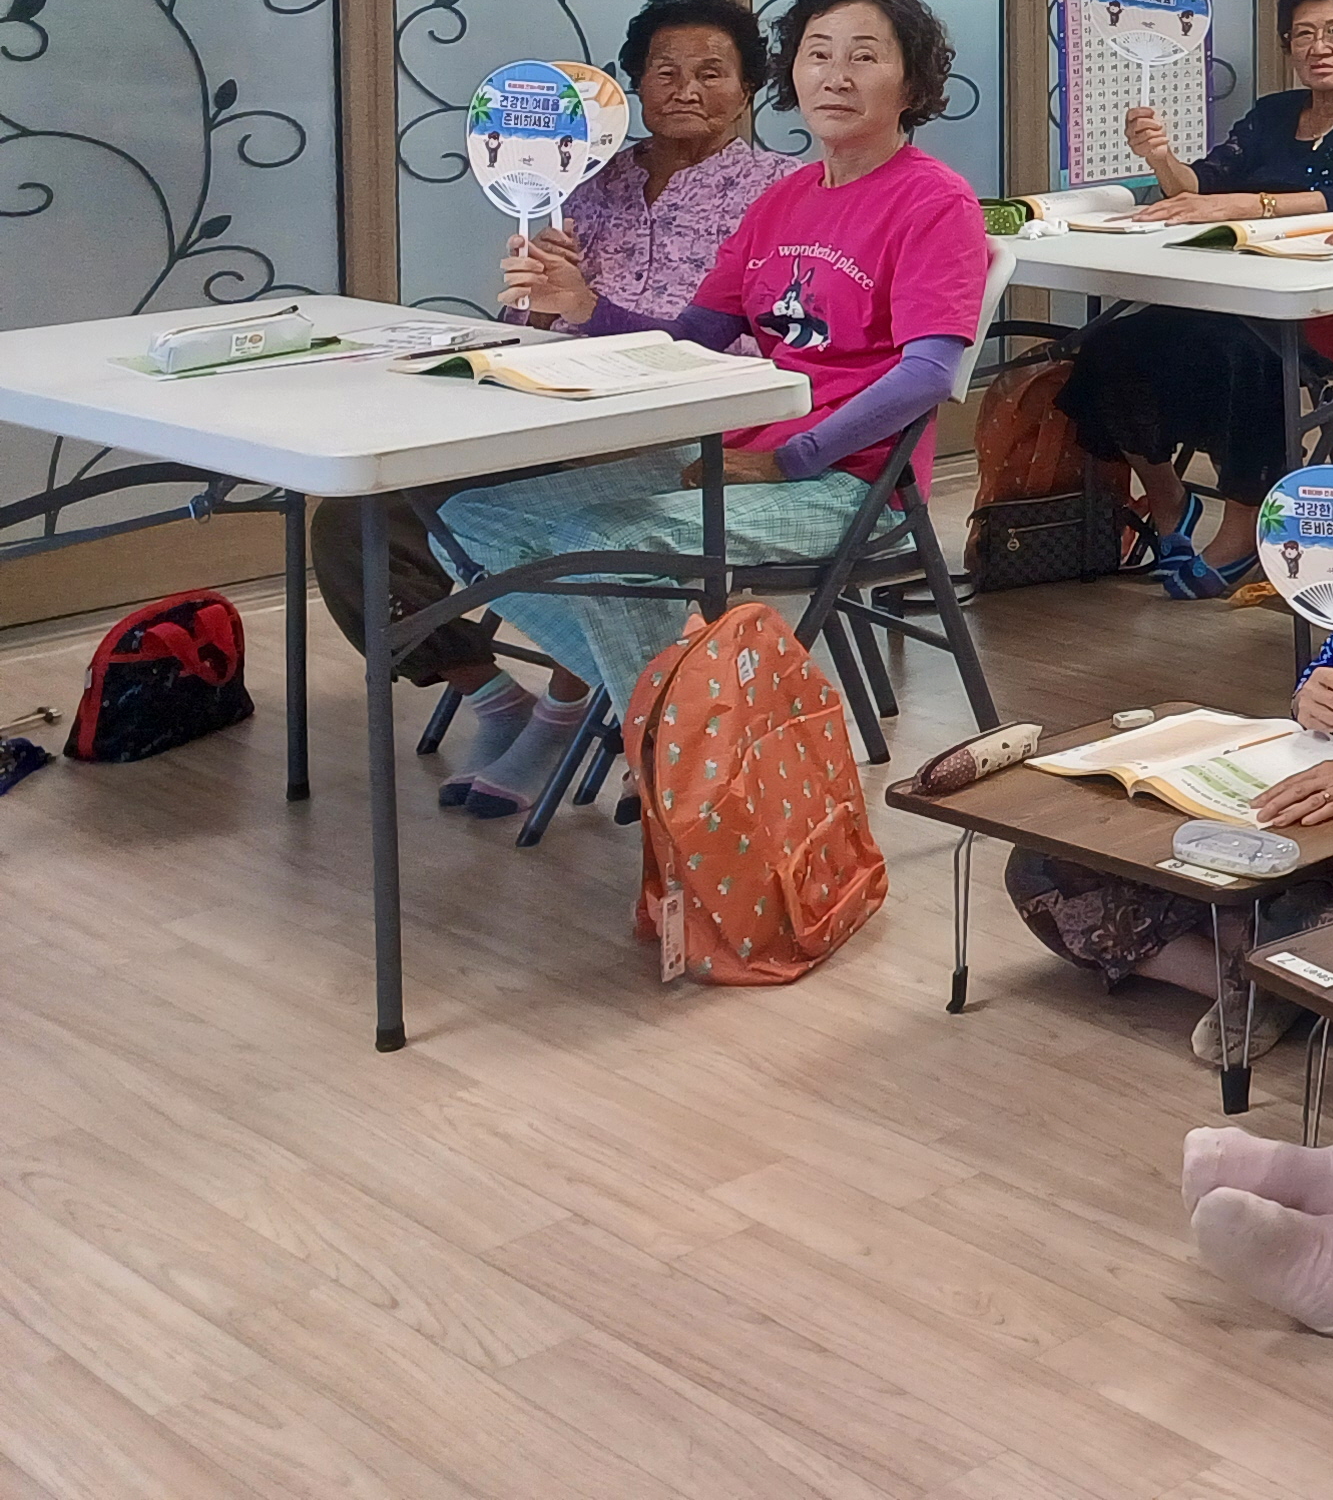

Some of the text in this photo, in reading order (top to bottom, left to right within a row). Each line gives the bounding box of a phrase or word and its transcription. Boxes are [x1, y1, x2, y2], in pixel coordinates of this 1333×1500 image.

[500, 95, 529, 109] 건강한
[504, 113, 555, 128] 준비하세요!
[833, 257, 874, 290] place
[1294, 502, 1331, 517] 건강한
